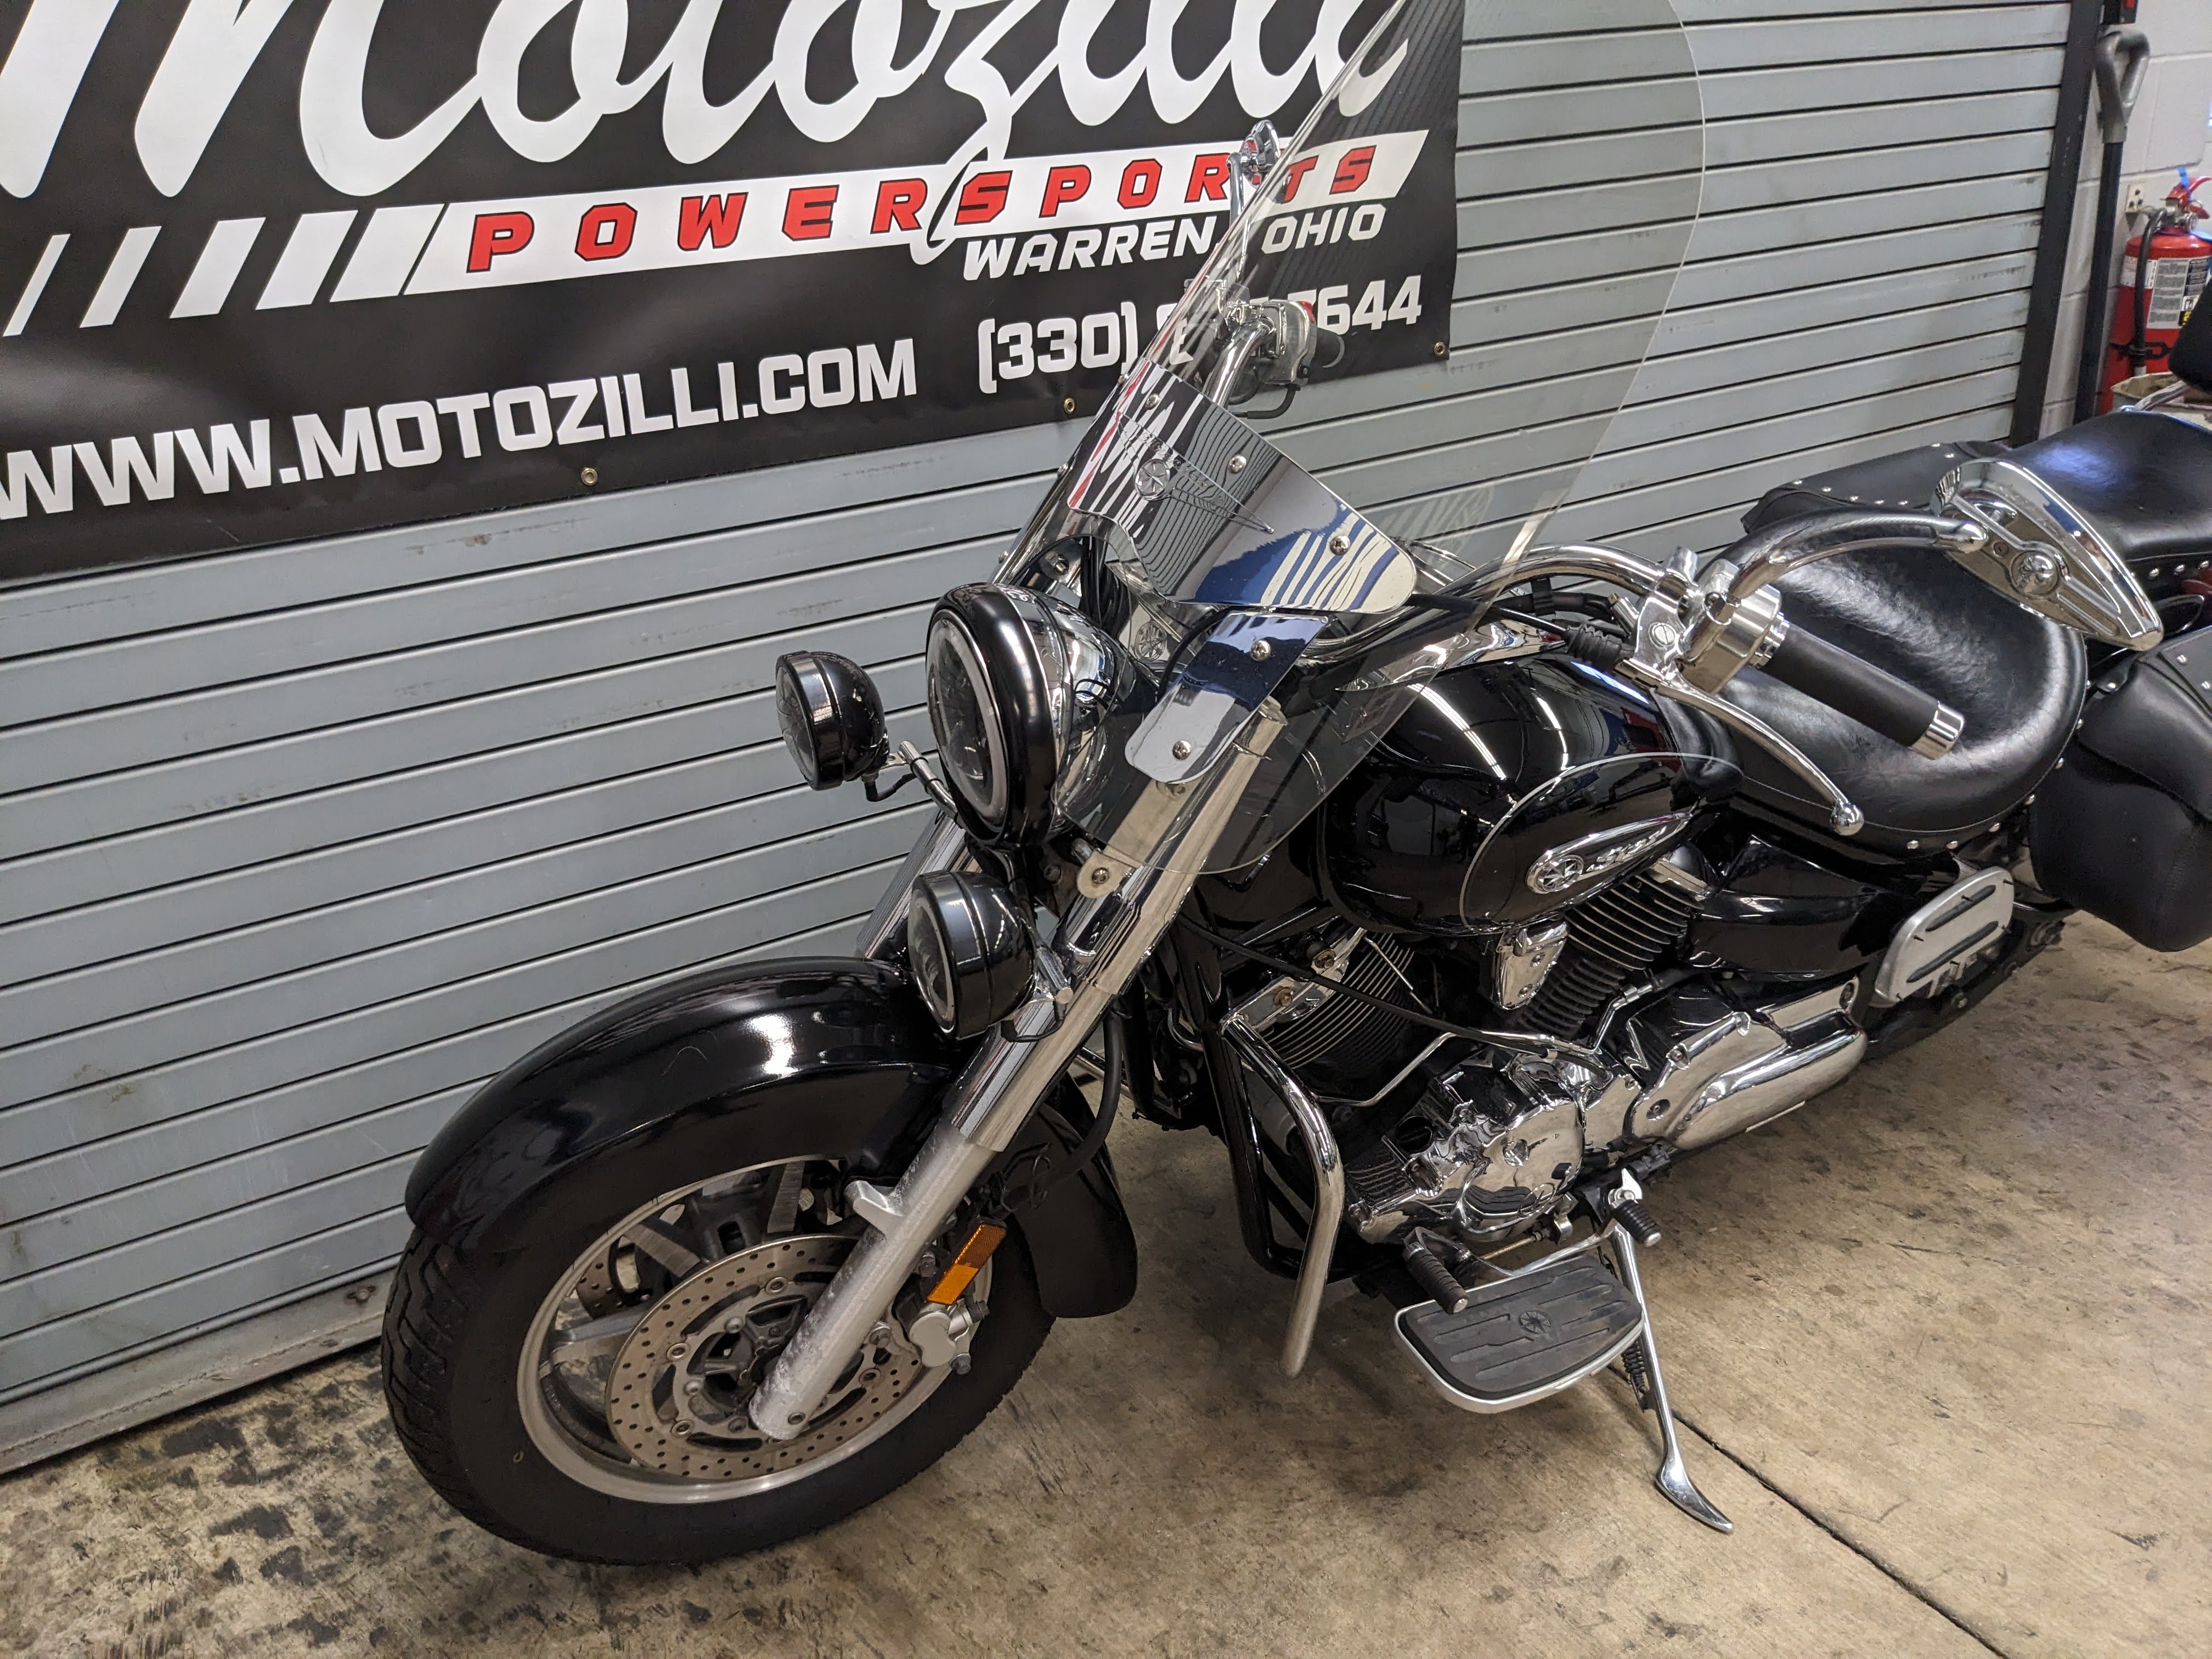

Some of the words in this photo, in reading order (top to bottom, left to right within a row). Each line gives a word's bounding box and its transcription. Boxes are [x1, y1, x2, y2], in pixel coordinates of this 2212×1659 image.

[466, 145, 1378, 273] POWERSPORTS
[1262, 204, 1386, 254] OHIO
[0, 338, 917, 520] WWW.MOTOZILLI.COM
[978, 301, 1139, 394] (330)
